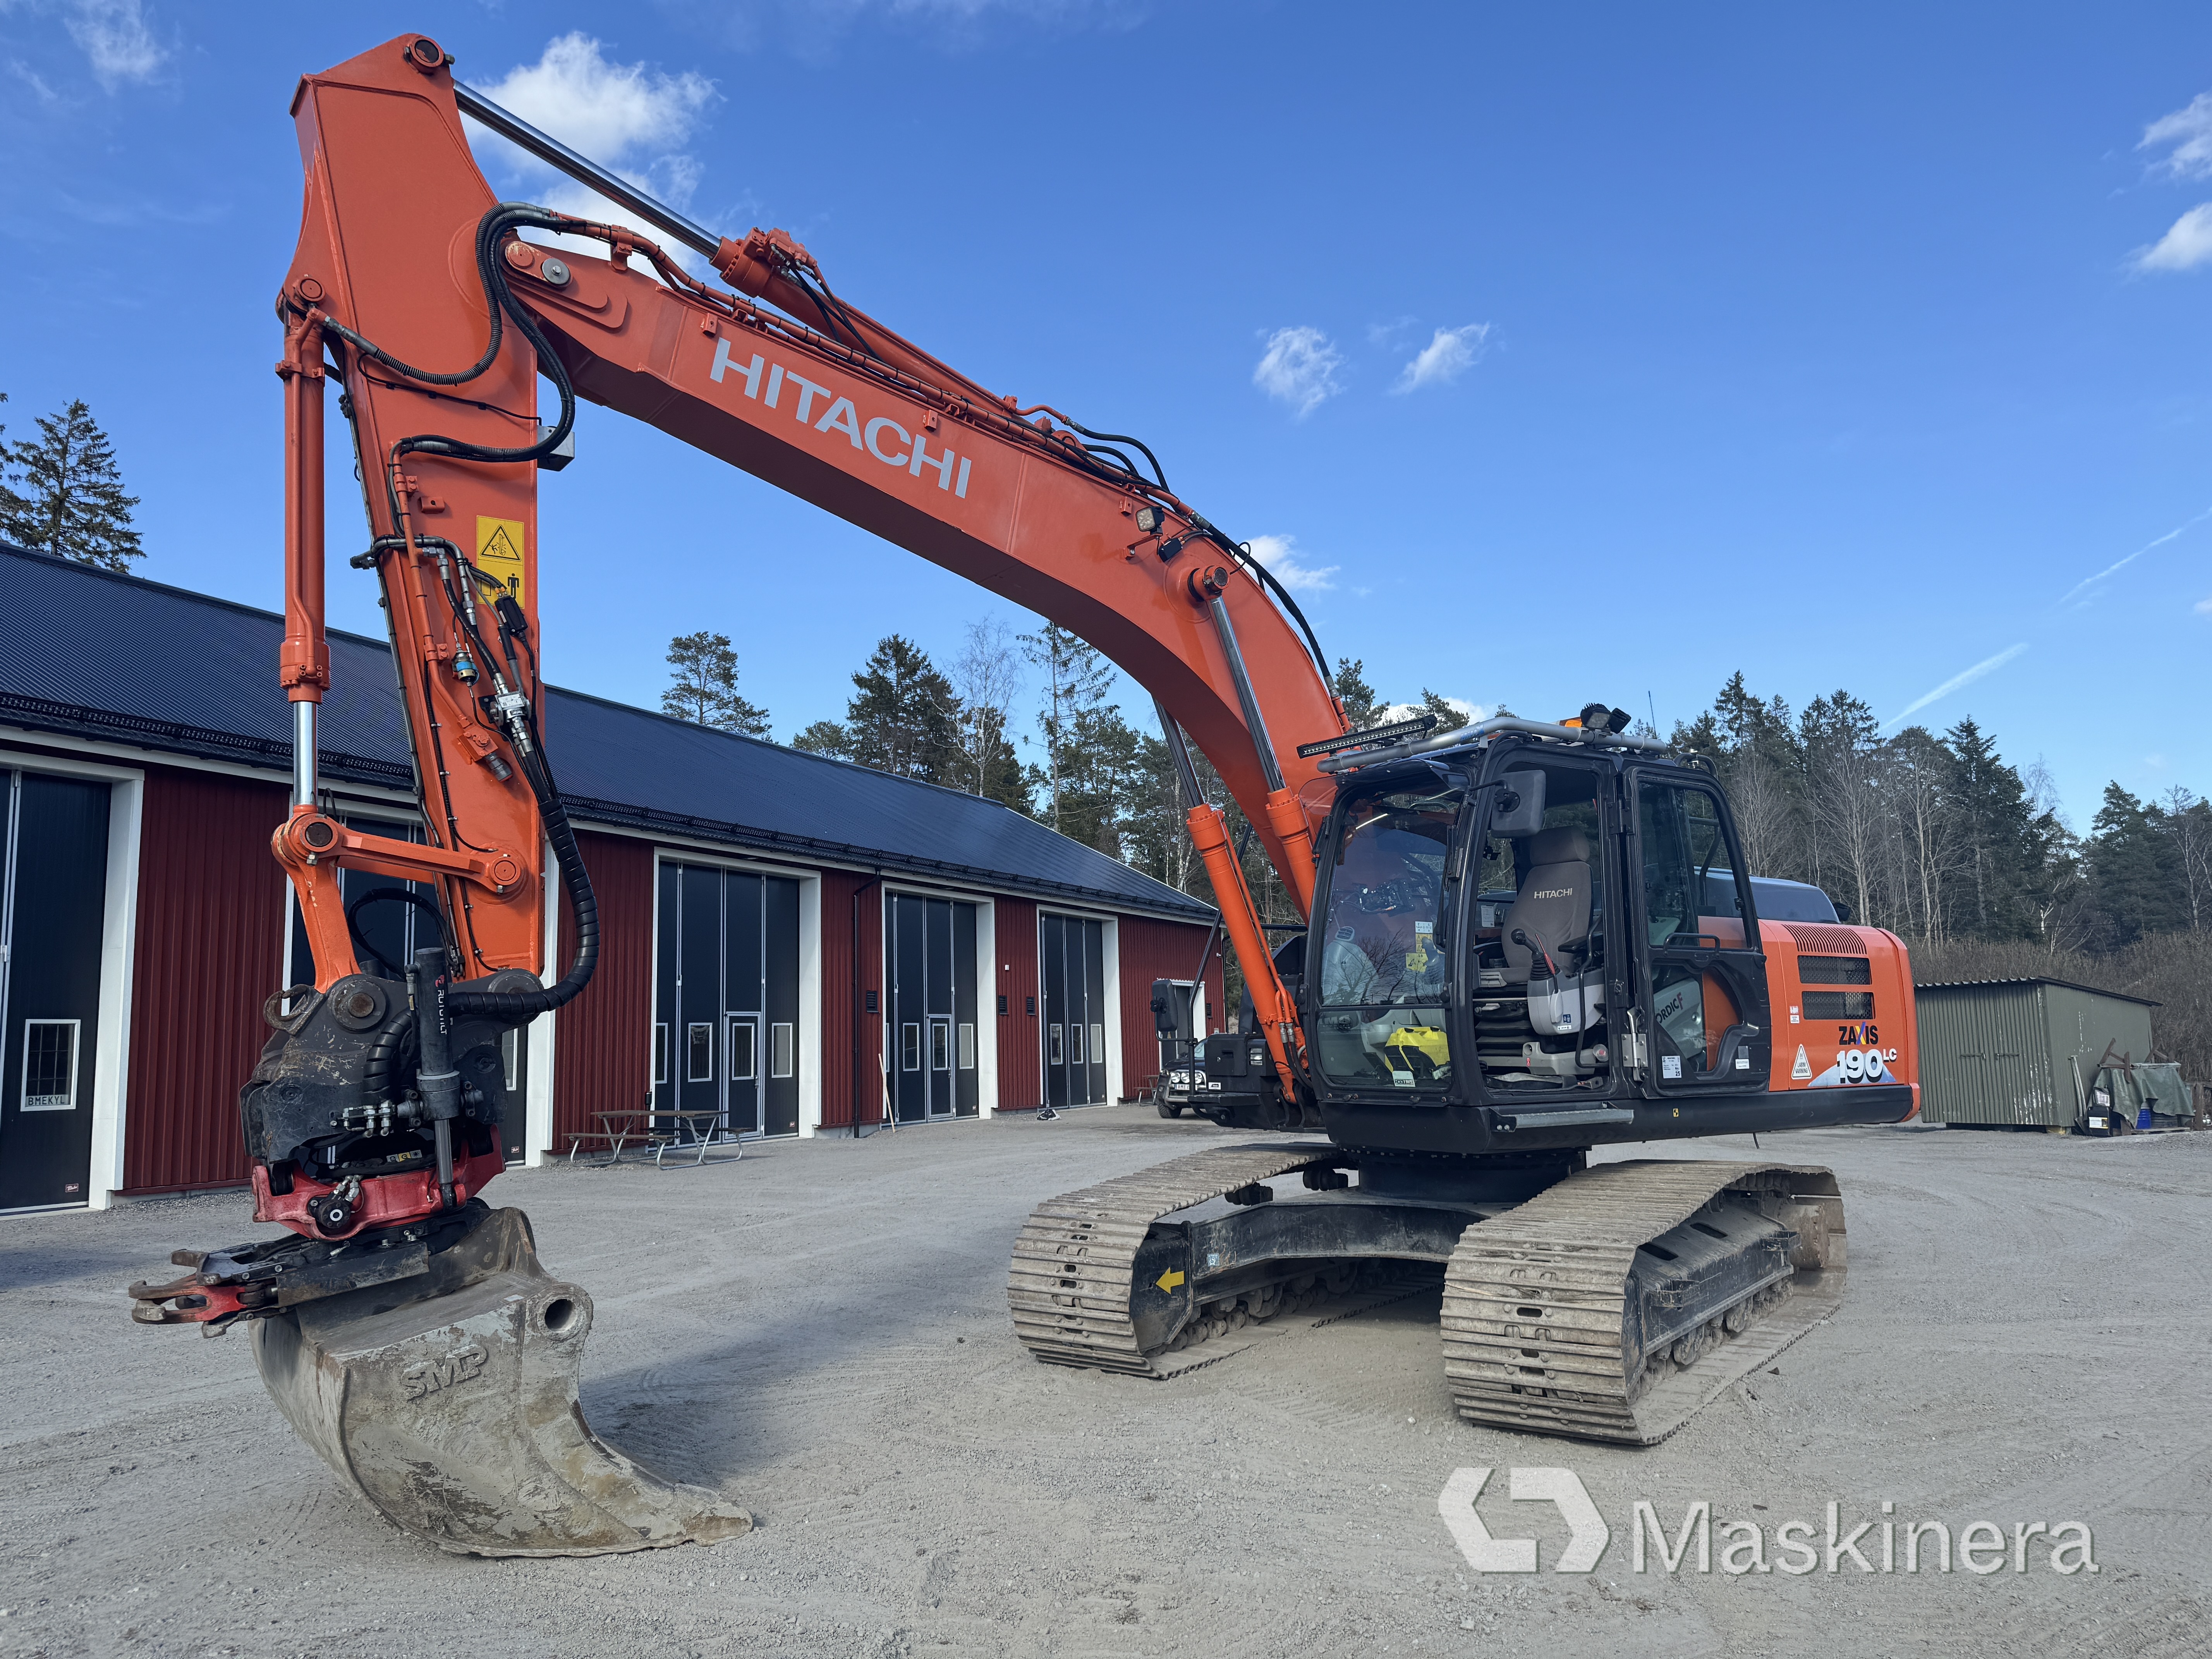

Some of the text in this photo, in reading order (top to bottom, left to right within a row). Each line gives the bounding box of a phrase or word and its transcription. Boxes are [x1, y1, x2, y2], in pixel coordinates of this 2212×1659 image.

[709, 337, 972, 499] HITACHI
[1534, 888, 1573, 899] HITACHI
[1838, 1022, 1879, 1045] ZAXIS
[28, 1096, 65, 1106] BMEKYL
[400, 1345, 489, 1402] SMP
